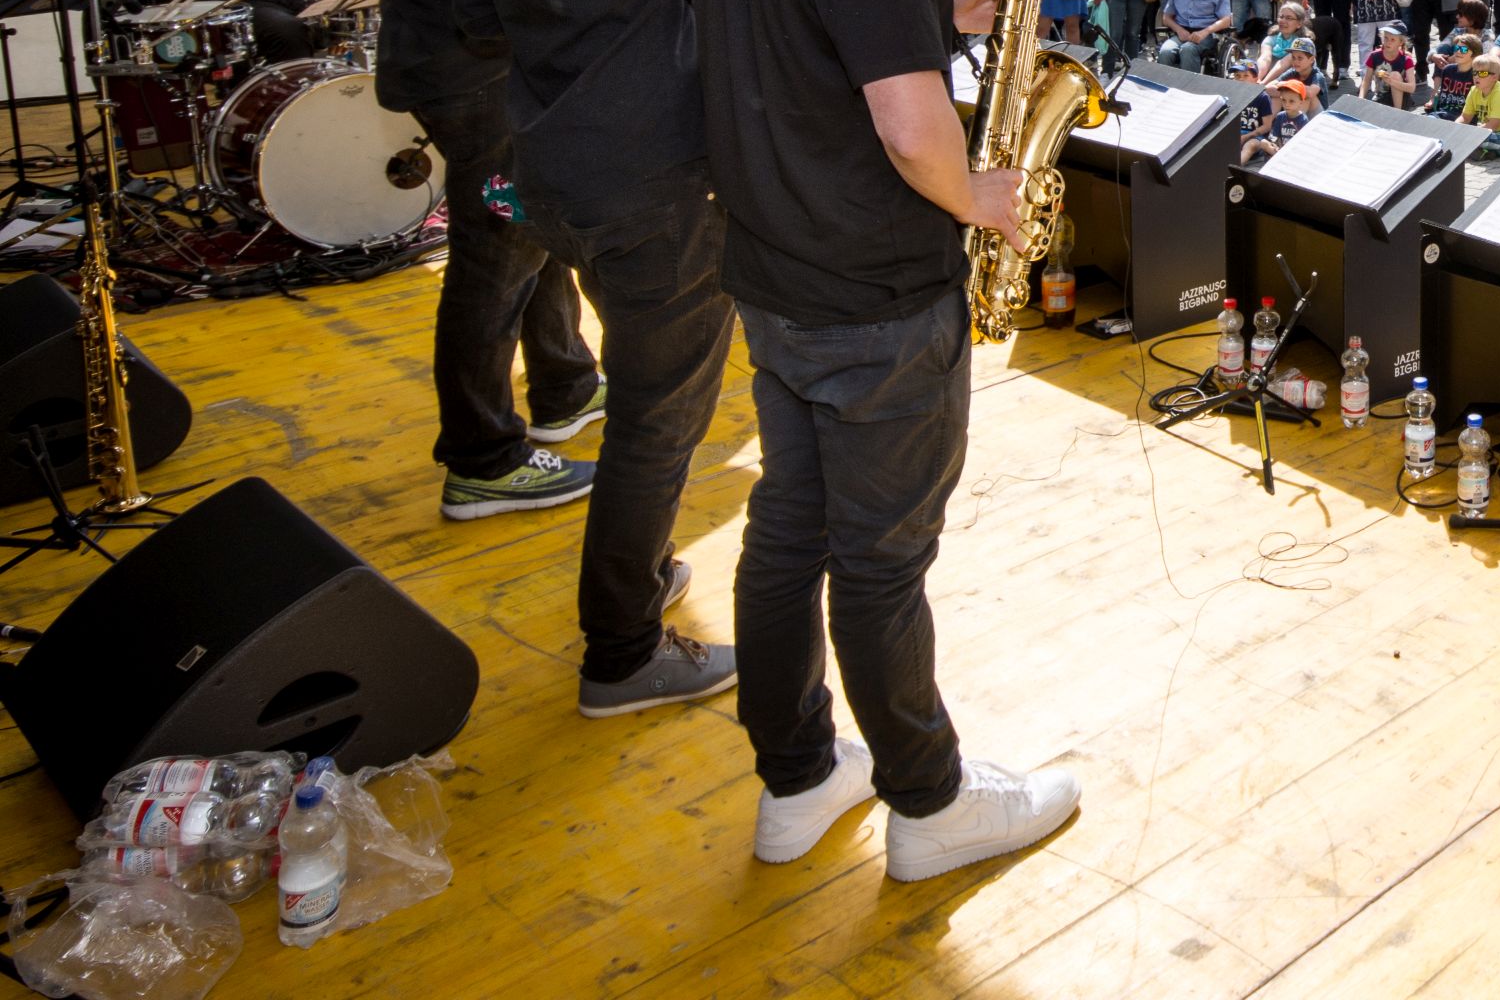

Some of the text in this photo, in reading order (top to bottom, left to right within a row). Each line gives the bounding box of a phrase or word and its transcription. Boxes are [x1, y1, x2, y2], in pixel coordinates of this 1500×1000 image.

[1442, 77, 1472, 96] SURF
[1178, 279, 1227, 301] JAZZRAUSC
[1179, 292, 1219, 312] BIGBAND
[1393, 349, 1420, 366] JAZZR
[1394, 361, 1420, 378] BIGB
